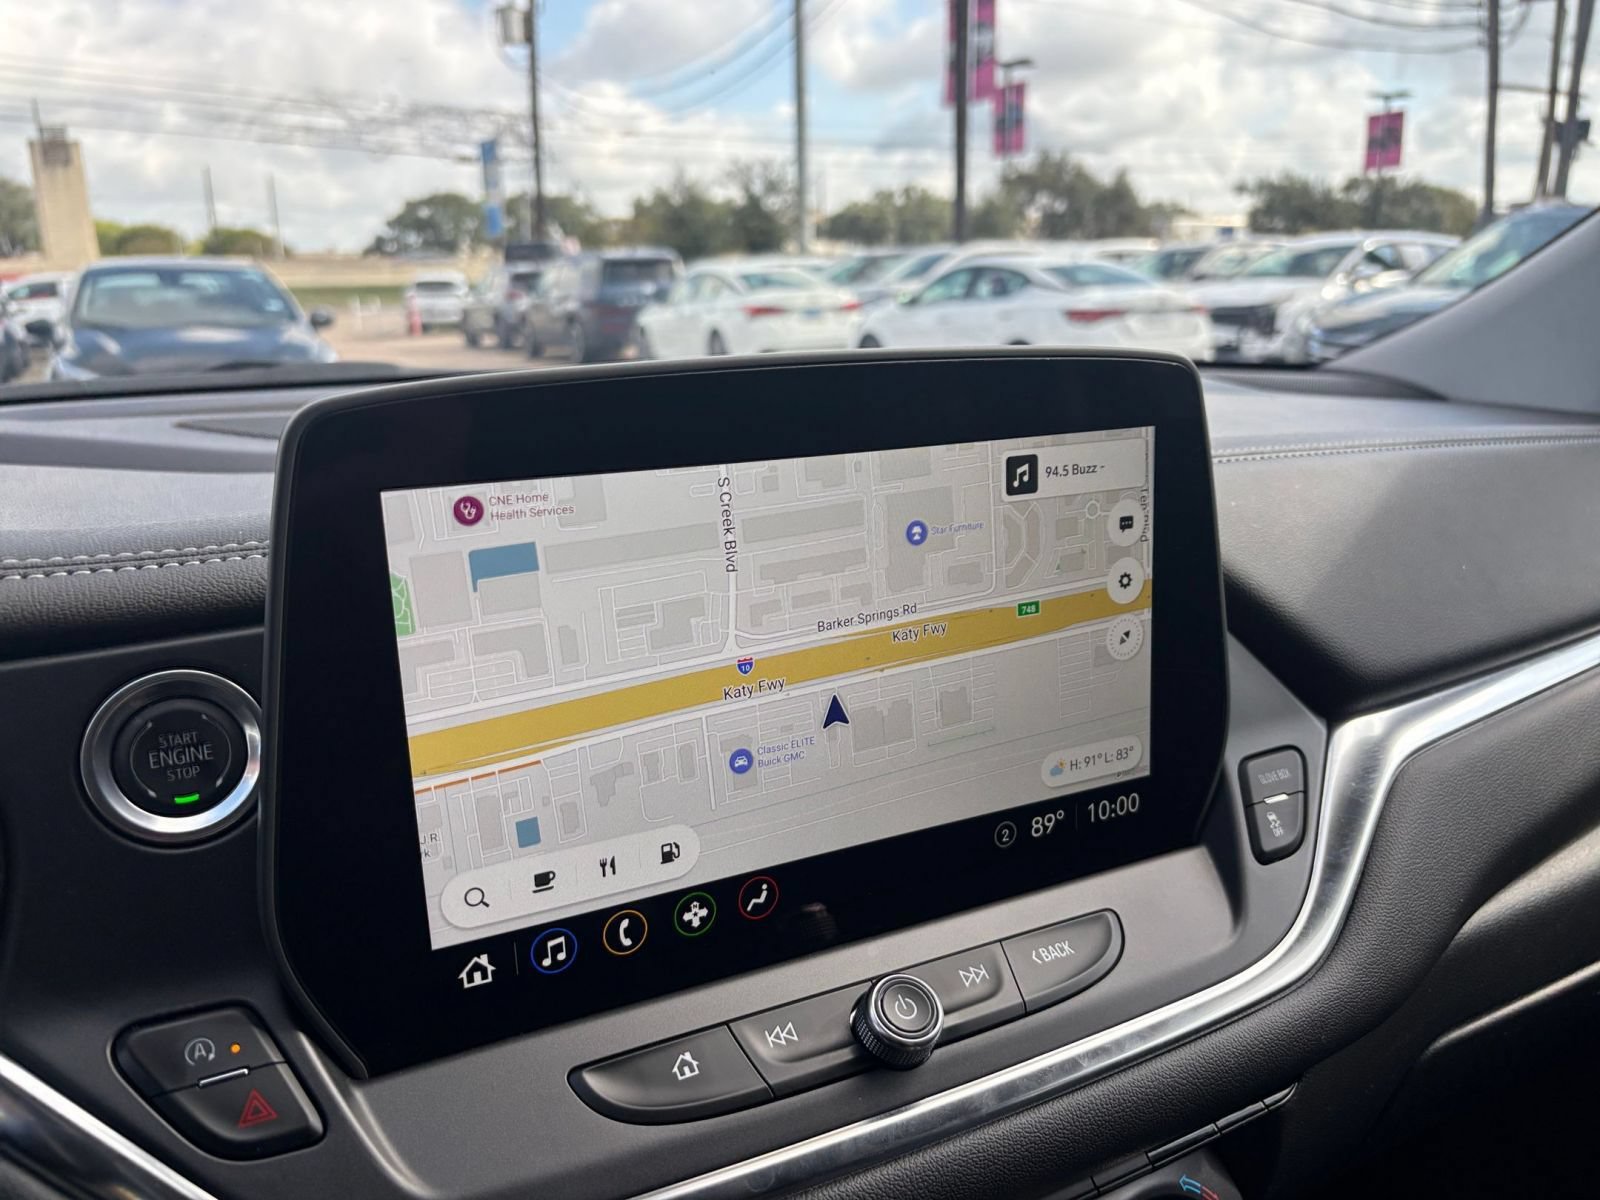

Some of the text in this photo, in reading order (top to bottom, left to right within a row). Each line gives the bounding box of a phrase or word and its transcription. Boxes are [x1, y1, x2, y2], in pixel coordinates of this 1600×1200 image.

[1045, 464, 1069, 478] 94.5
[1071, 463, 1098, 476] Buzz
[489, 492, 549, 507] CNE Home
[490, 505, 575, 521] Health Services
[717, 477, 739, 573] S Creek Blvd
[816, 603, 918, 633] Barker Springs Rd
[892, 623, 947, 643] Katy Fwy
[741, 664, 751, 672] 10
[723, 678, 786, 701] Katy Fwy
[159, 731, 198, 749] START
[757, 736, 816, 756] Classic ELITE
[148, 743, 214, 769] ENGINE
[757, 751, 805, 768] Buick GMC
[1070, 745, 1134, 772] H: 91° L: 83°
[167, 765, 200, 782] STOP
[1088, 792, 1140, 823] 10:00
[1031, 809, 1065, 838] 89°
[1001, 828, 1010, 842] 2
[1038, 940, 1075, 962] BACK
